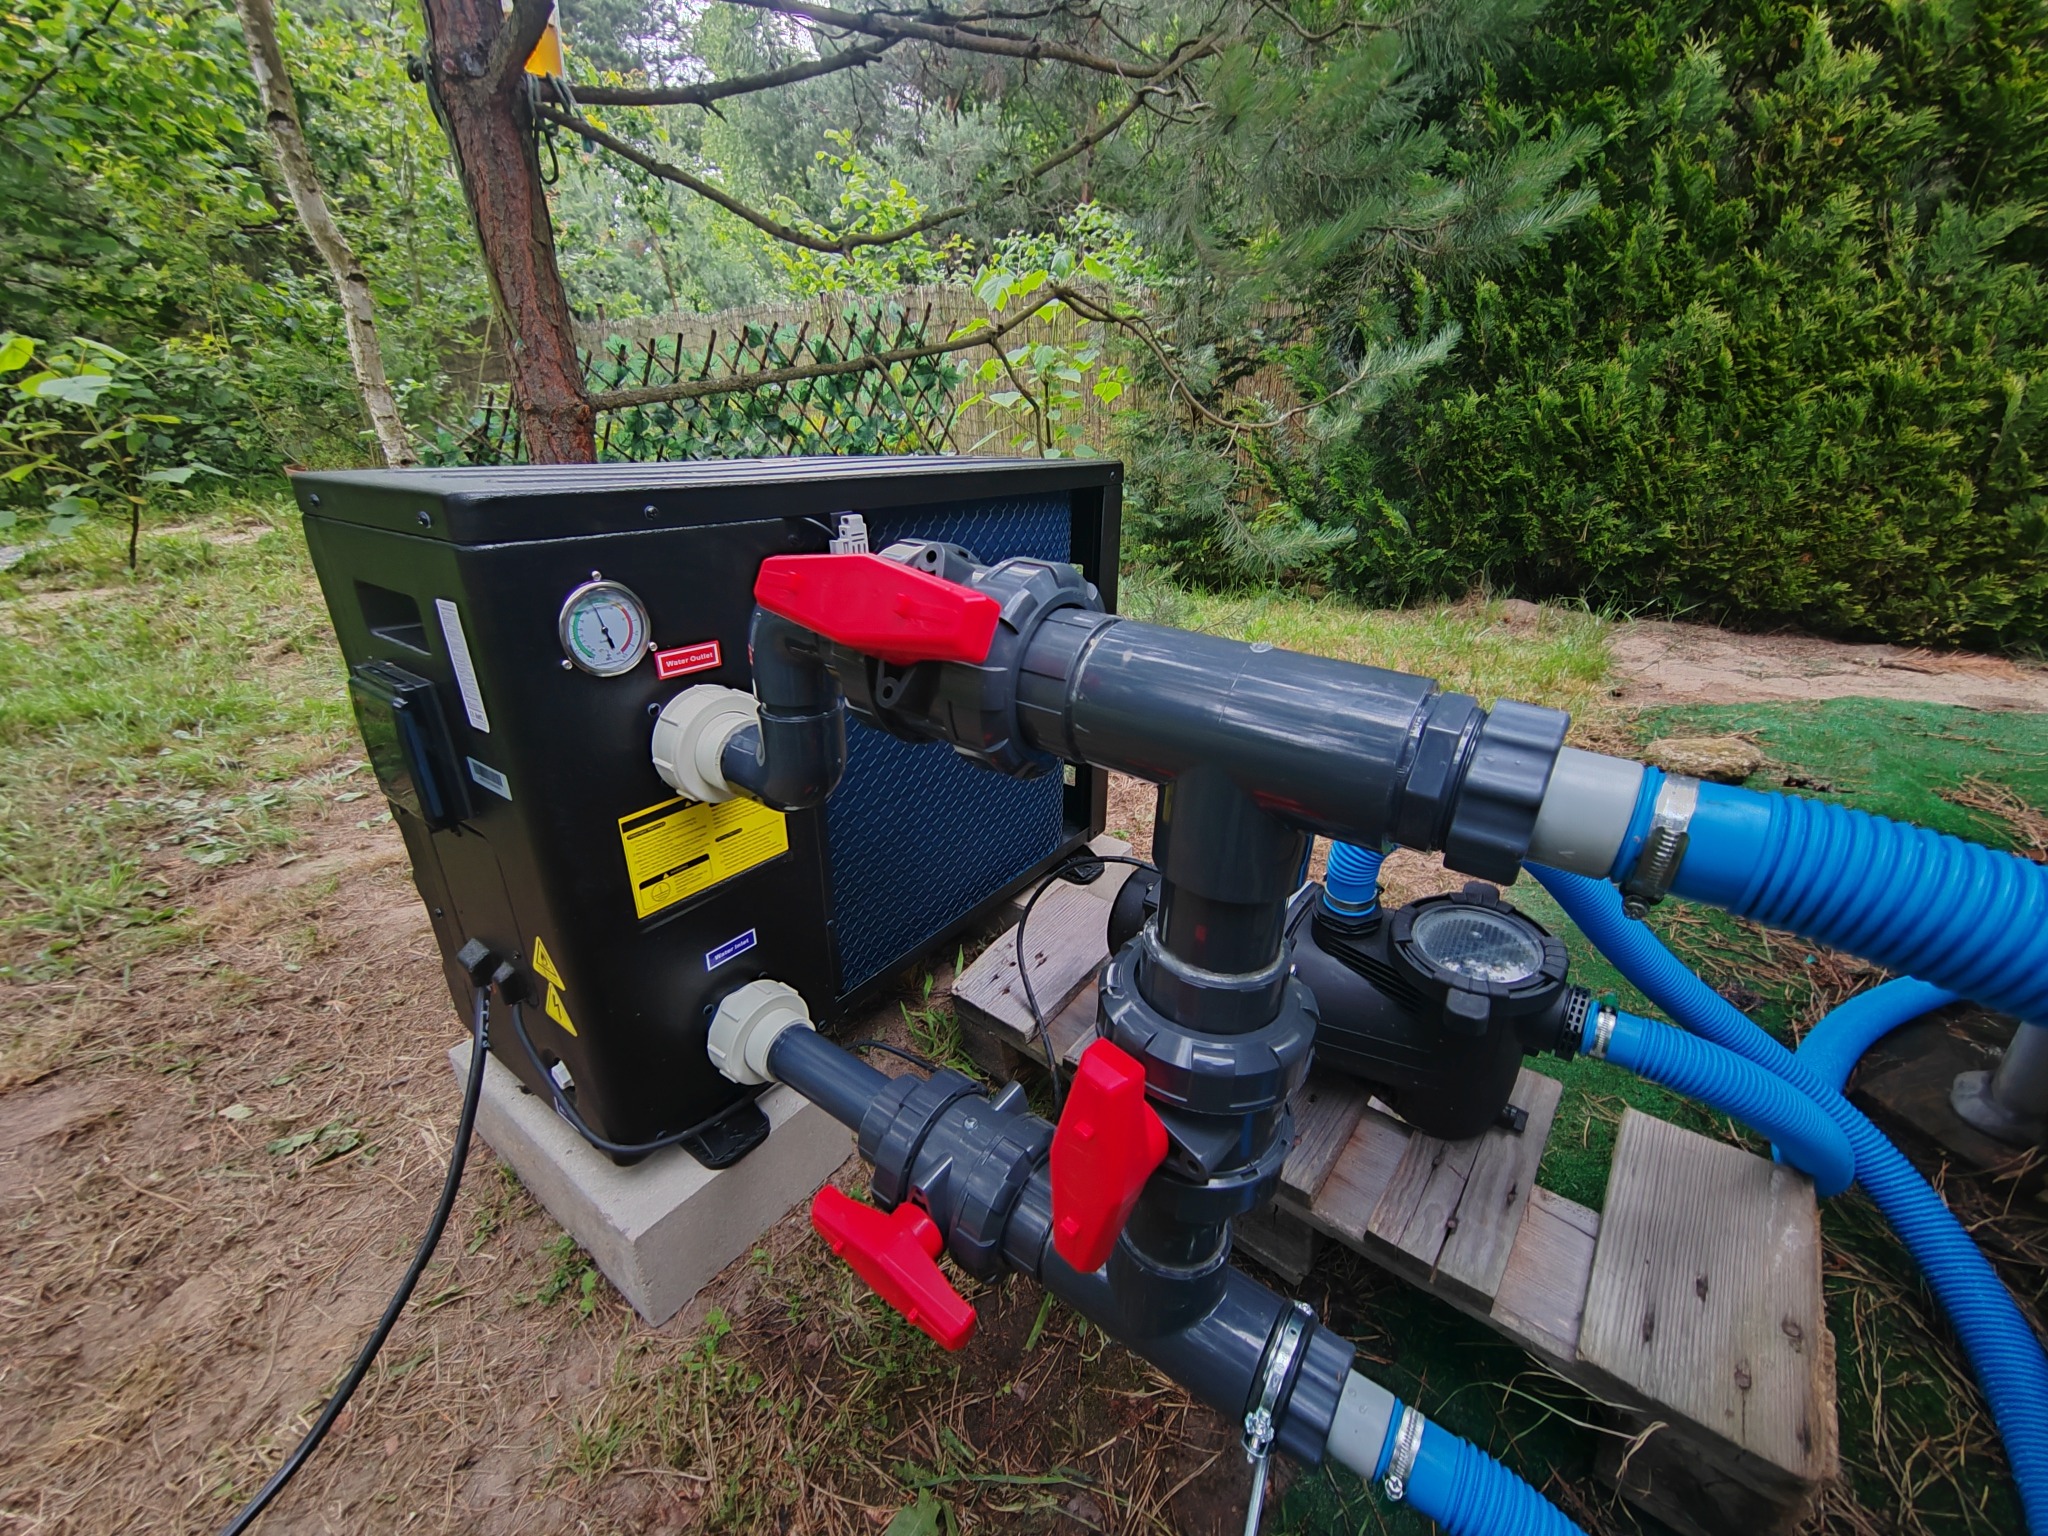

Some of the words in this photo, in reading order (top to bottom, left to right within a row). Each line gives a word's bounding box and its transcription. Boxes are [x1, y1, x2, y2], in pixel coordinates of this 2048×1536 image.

[666, 658, 689, 668] Water
[690, 653, 713, 662] Outlet
[715, 947, 734, 960] Water
[734, 938, 750, 950] Inlet
